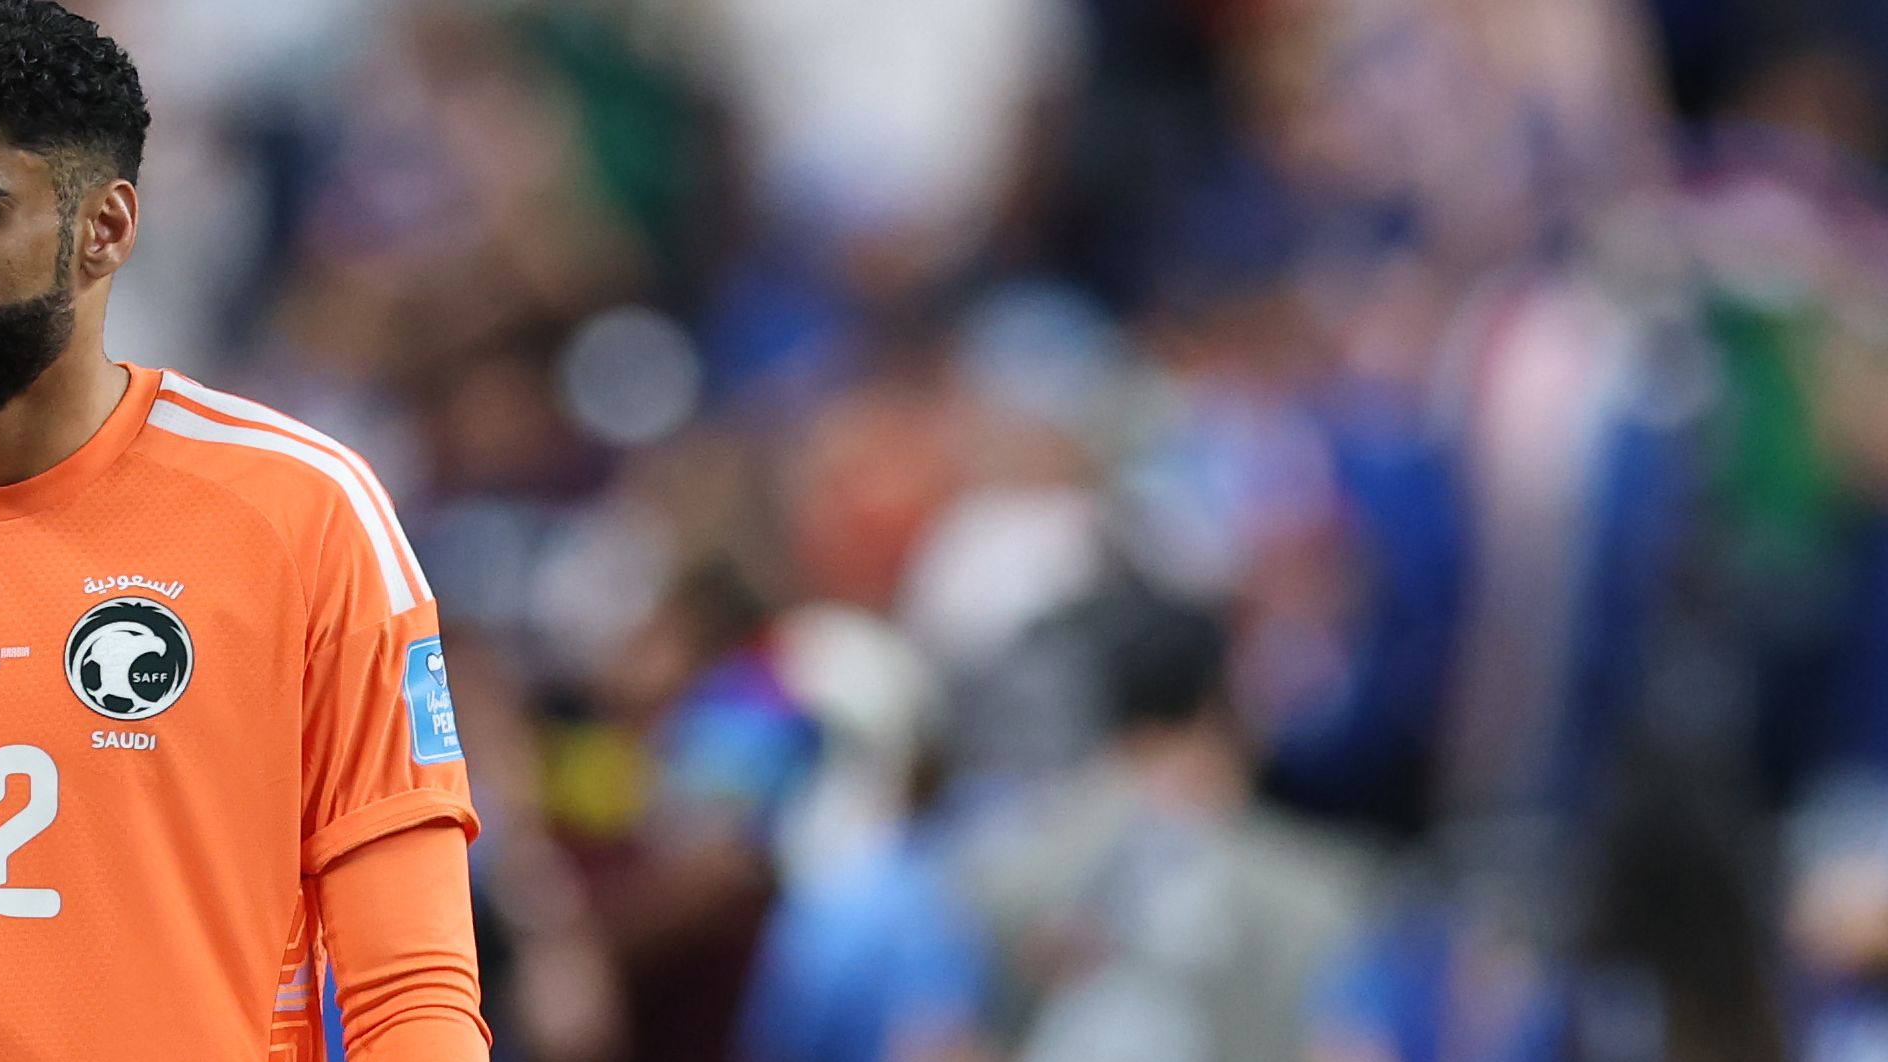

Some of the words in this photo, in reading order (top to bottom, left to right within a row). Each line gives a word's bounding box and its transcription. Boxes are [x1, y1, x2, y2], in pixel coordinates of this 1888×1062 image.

[83, 574, 185, 600] السعودية
[132, 672, 168, 684] SAFF
[91, 730, 157, 751] SAUDI
